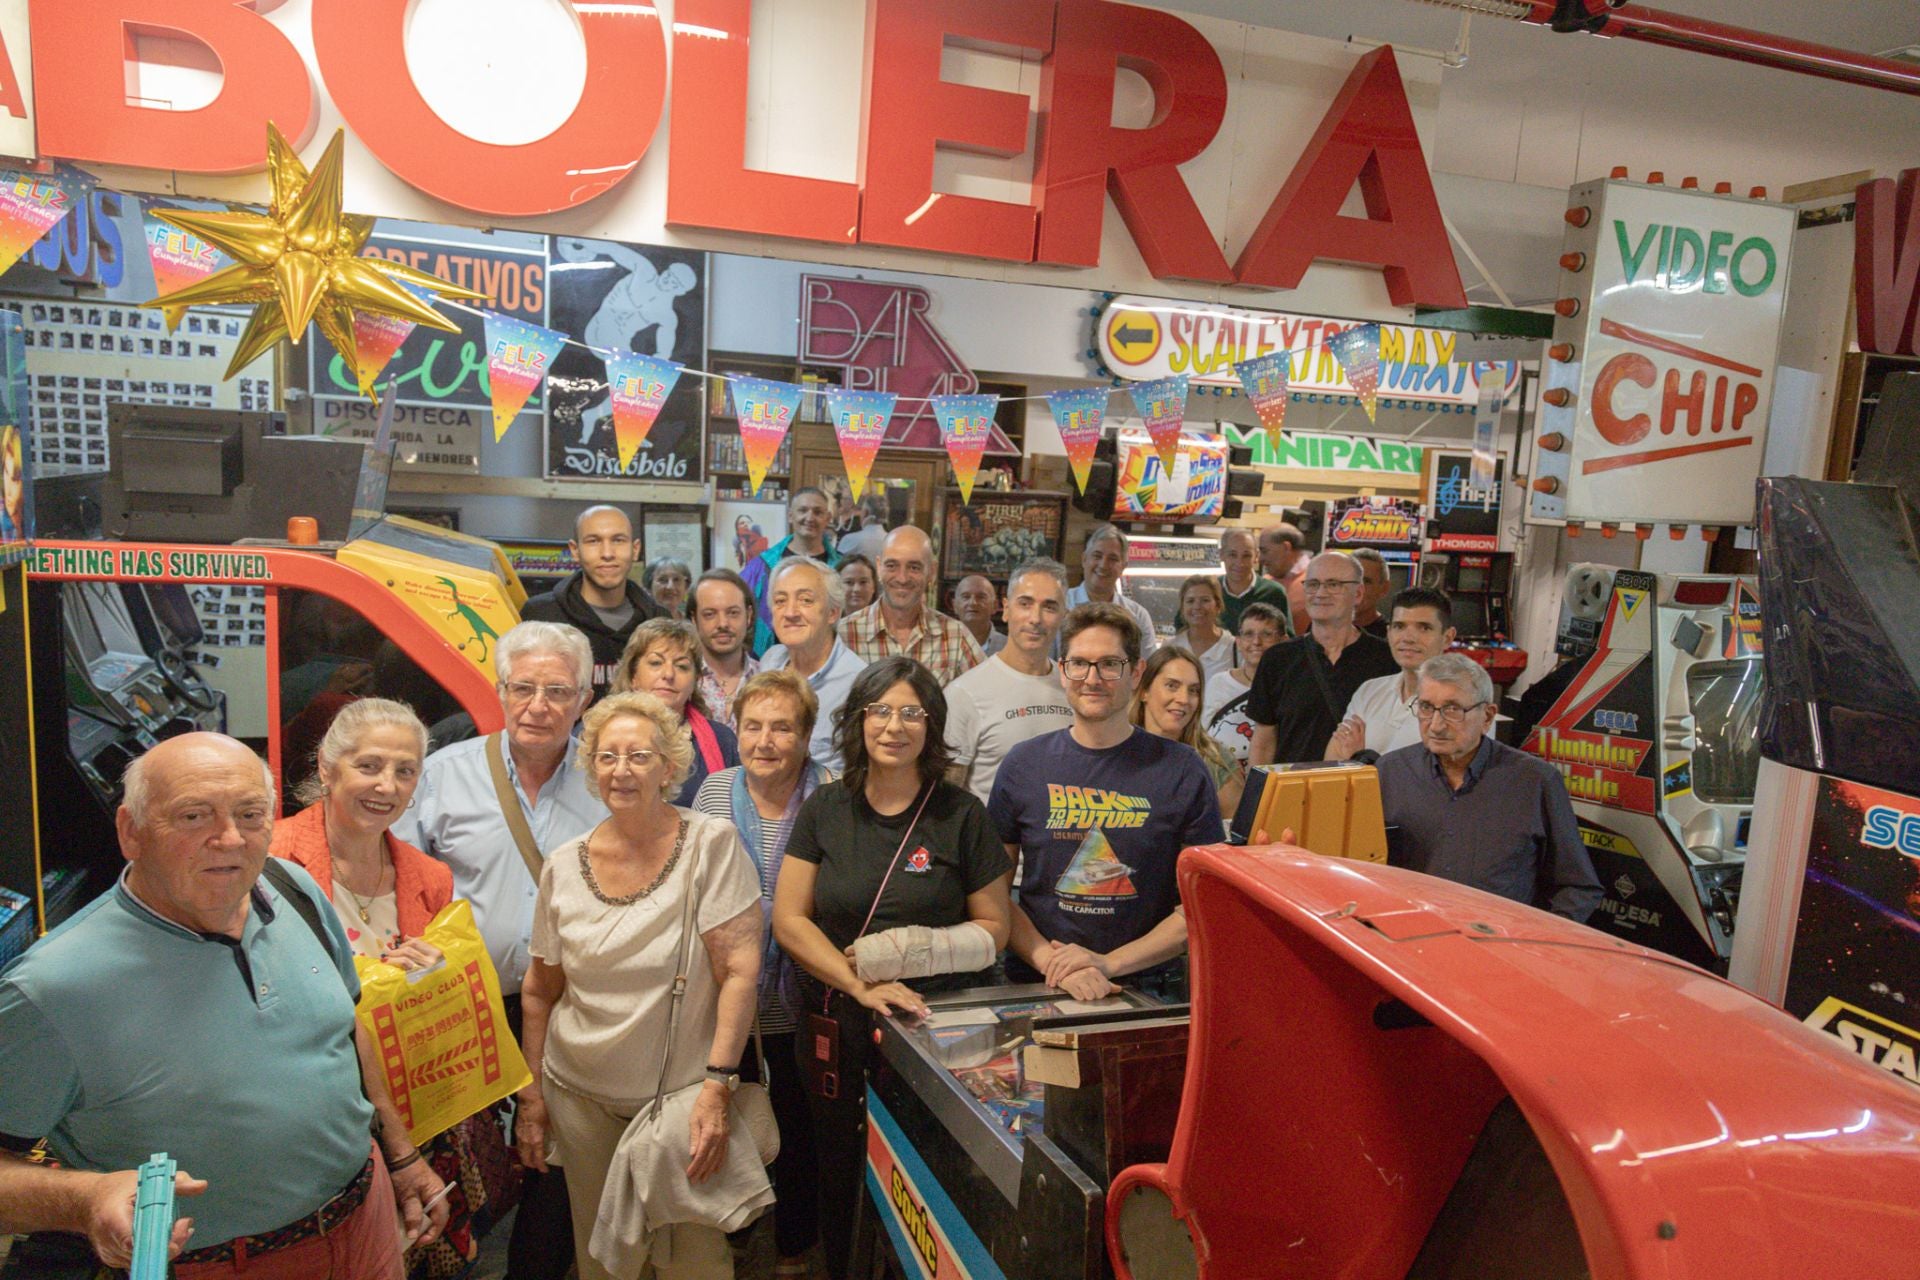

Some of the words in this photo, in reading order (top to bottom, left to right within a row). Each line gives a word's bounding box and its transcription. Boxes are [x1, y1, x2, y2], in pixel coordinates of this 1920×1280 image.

[28, 0, 1467, 310] BOLERA
[155, 226, 216, 260] FELIZ
[1613, 219, 1777, 297] VIDEO
[362, 246, 543, 313] ATIVOS
[806, 281, 964, 376] BAR
[494, 339, 547, 369] FELIZ
[1168, 308, 1360, 385] SCALEXTR
[1374, 325, 1469, 395] MAXI
[615, 373, 665, 400] FELIZ
[1591, 352, 1758, 446] CHIP
[325, 400, 472, 427] DISCOTECA
[743, 399, 790, 424] FELIZ
[840, 411, 884, 432] FELIZ
[1062, 409, 1100, 430] FELIZ
[1145, 398, 1181, 418] FELIZ
[352, 428, 424, 444] PRBIDA
[437, 433, 454, 446] LA
[946, 416, 988, 436] FELIZ
[1436, 539, 1496, 550] THOMSON
[120, 551, 163, 576] HAS
[170, 552, 272, 579] SURVIVED.
[1005, 704, 1073, 720] GHOSTBUSTERS
[1594, 709, 1638, 732] SEGA
[1554, 763, 1618, 801] lade
[1047, 784, 1140, 810] BACK
[1046, 819, 1066, 829] THE
[1065, 810, 1149, 829] FUTURE
[1050, 809, 1066, 820] TO
[1579, 829, 1615, 848] TTACK
[1600, 900, 1661, 927] NIDESA
[396, 991, 433, 1012] VIDEO
[437, 973, 465, 994] CLUB
[890, 1163, 938, 1279] Sonic
